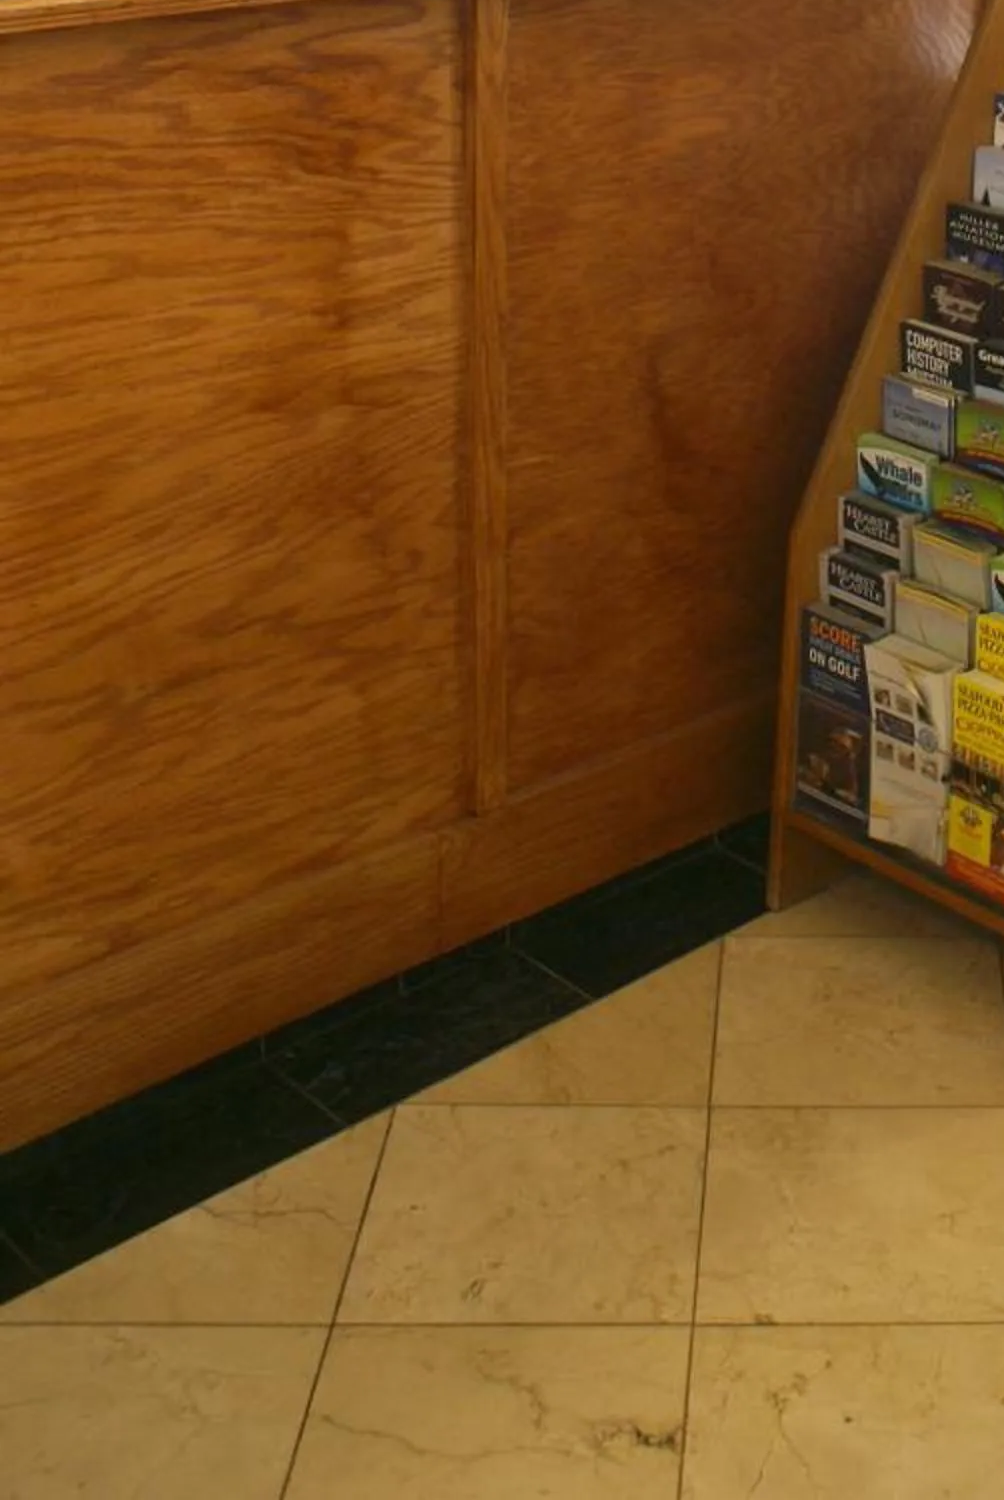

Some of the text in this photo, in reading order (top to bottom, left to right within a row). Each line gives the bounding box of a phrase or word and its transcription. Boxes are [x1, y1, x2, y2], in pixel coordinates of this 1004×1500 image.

[906, 329, 963, 363] COMPUTER
[906, 348, 950, 376] HISTORY
[875, 454, 923, 487] Whale
[854, 518, 897, 544] CASTLE
[839, 577, 883, 602] CASTLE
[809, 615, 861, 650] SCORE
[809, 648, 826, 668] ON
[828, 656, 861, 683] GOLF
